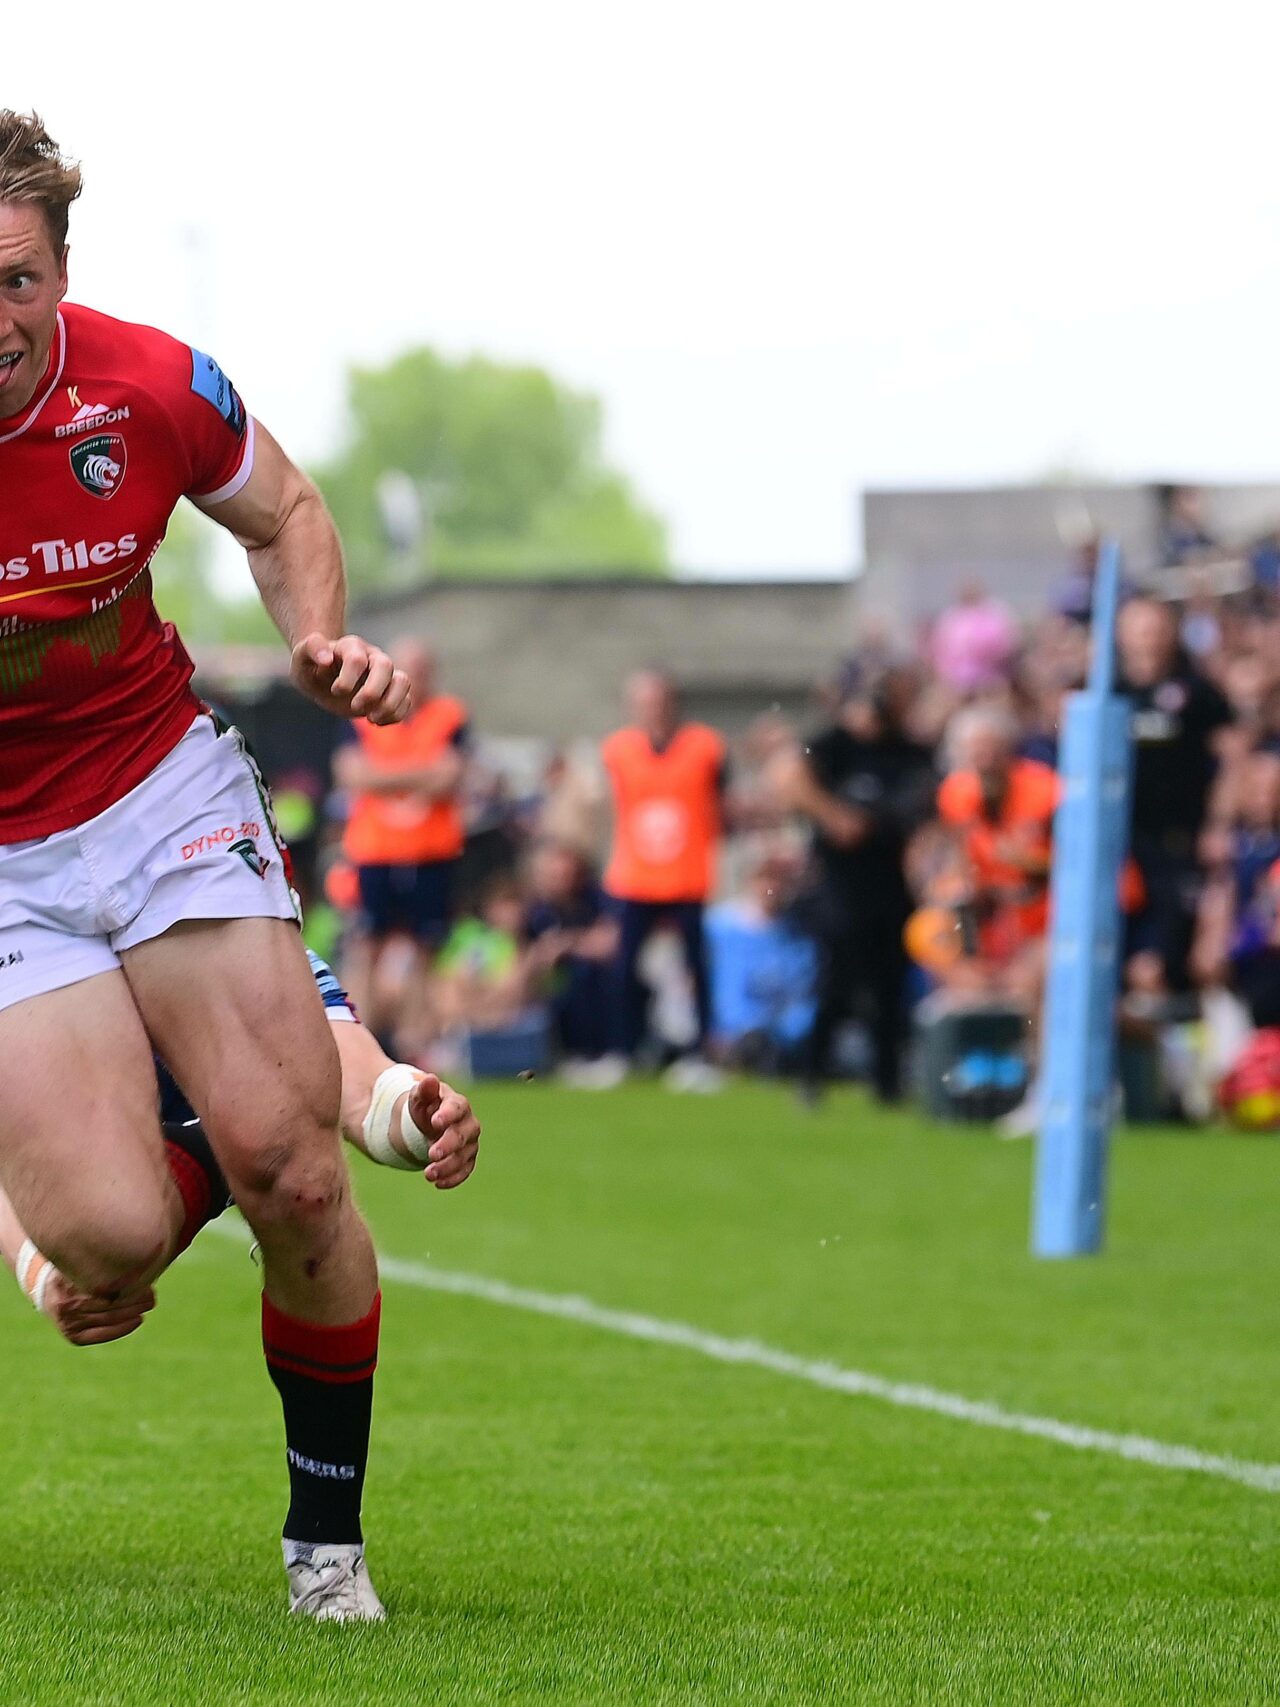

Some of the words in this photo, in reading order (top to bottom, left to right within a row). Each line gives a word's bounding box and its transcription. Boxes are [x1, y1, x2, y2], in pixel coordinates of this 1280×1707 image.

[67, 385, 82, 408] K
[55, 406, 129, 437] BREEDON
[32, 533, 138, 575] Tiles
